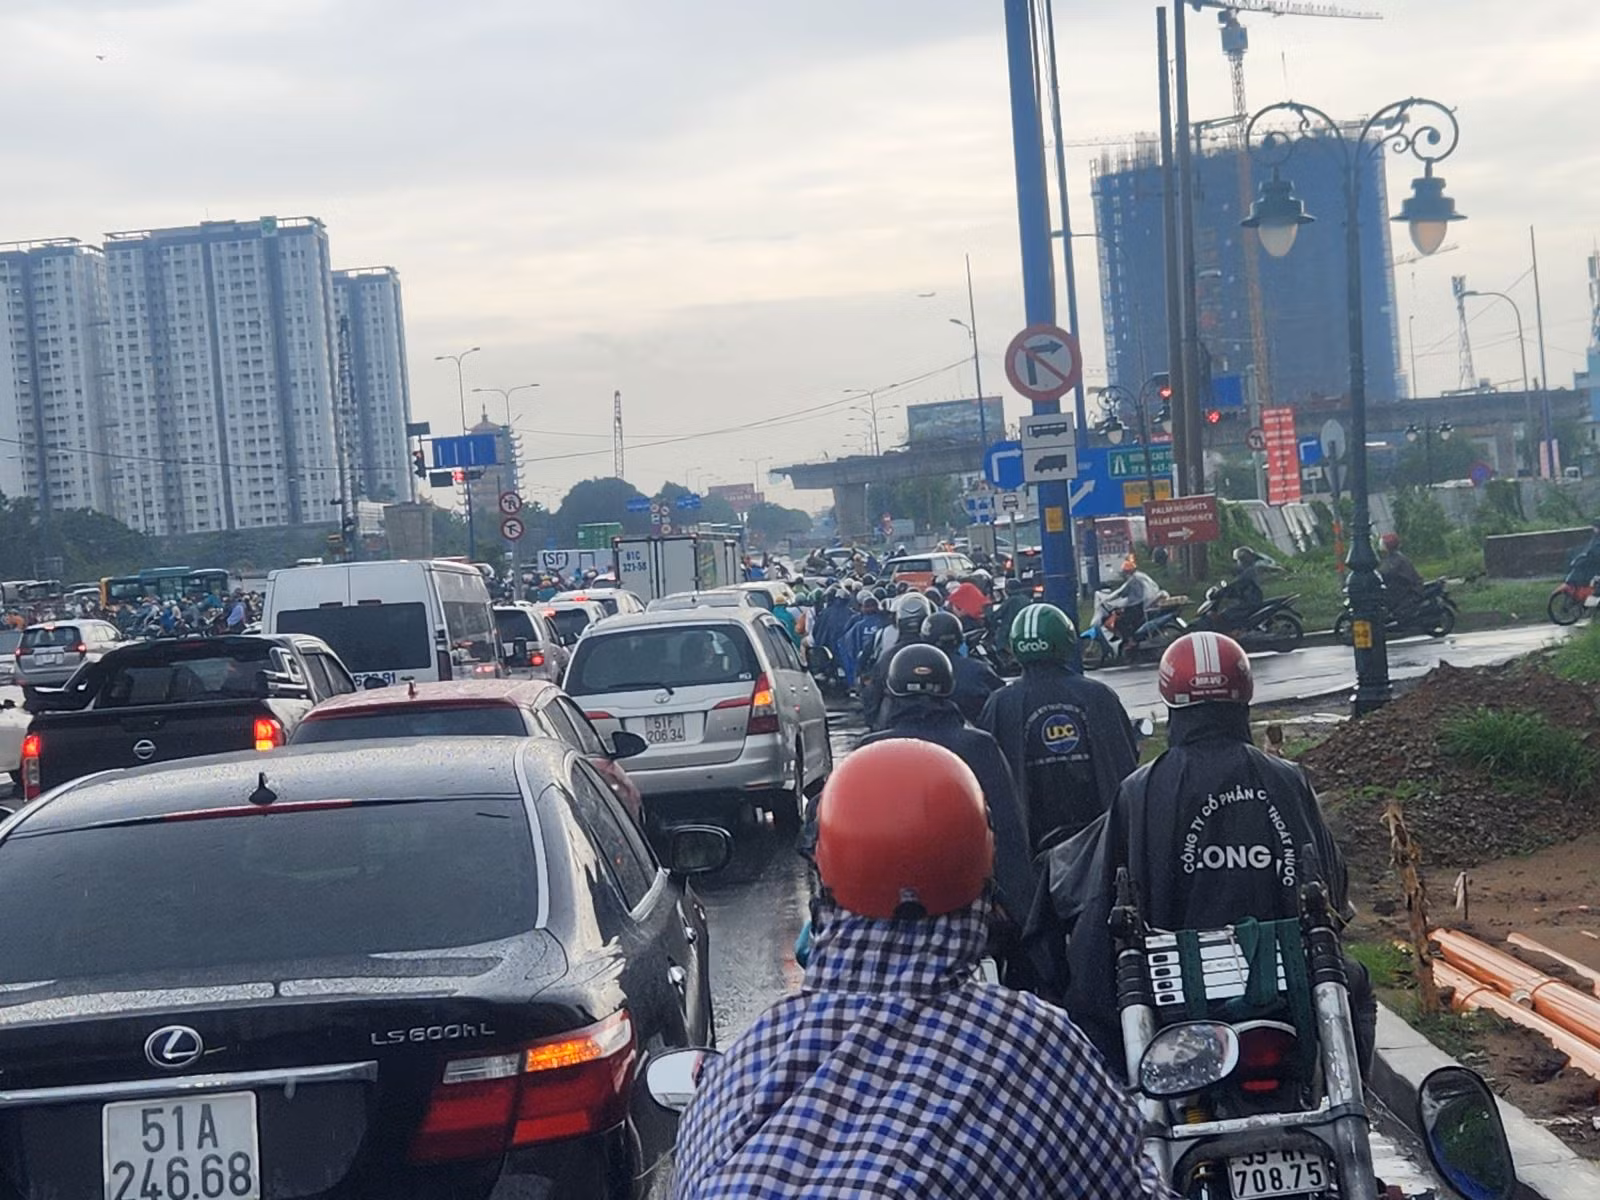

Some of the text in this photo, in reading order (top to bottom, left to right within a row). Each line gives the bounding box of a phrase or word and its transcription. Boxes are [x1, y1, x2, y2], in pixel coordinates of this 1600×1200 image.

[1151, 502, 1208, 514] PALM HEIGHTS
[1149, 513, 1213, 526] PALM RESIDENCE
[1017, 639, 1049, 653] Grab
[653, 716, 673, 729] 51F
[1046, 723, 1075, 740] UDC
[1180, 833, 1198, 874] CÔNG
[1190, 816, 1205, 833] TY
[1201, 793, 1219, 817] CỔ
[1267, 805, 1292, 846] THOÁT
[141, 1103, 218, 1153] 51A
[112, 1151, 252, 1200] 246.68
[1234, 1161, 1322, 1196] 708.75
